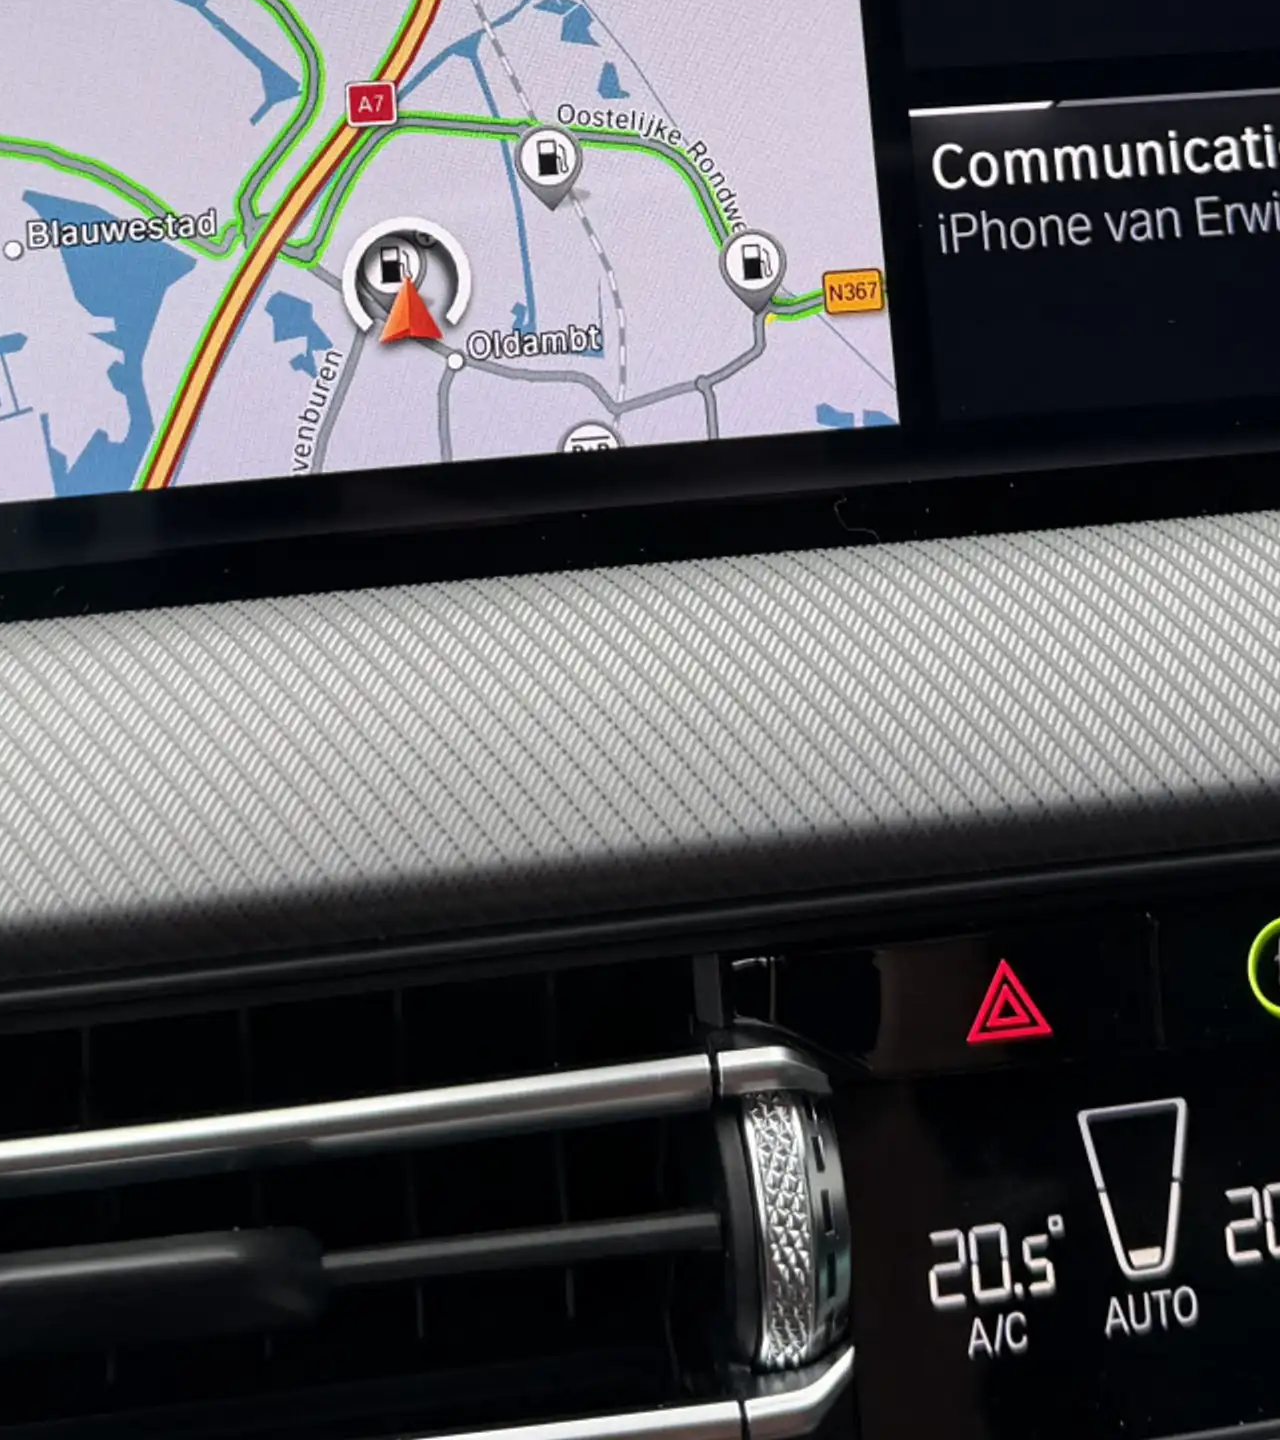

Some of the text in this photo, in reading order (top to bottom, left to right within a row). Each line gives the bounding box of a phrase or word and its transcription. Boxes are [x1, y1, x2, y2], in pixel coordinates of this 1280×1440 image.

[357, 94, 384, 114] A7
[557, 104, 681, 145] Oostelijke
[26, 209, 218, 249] Blauwestad
[937, 206, 1093, 255] iPhone
[1106, 208, 1181, 243] van
[829, 279, 878, 302] N367
[466, 323, 603, 360] Oldambt
[1104, 1285, 1199, 1340] AUTO
[967, 1312, 1028, 1359] A/C
